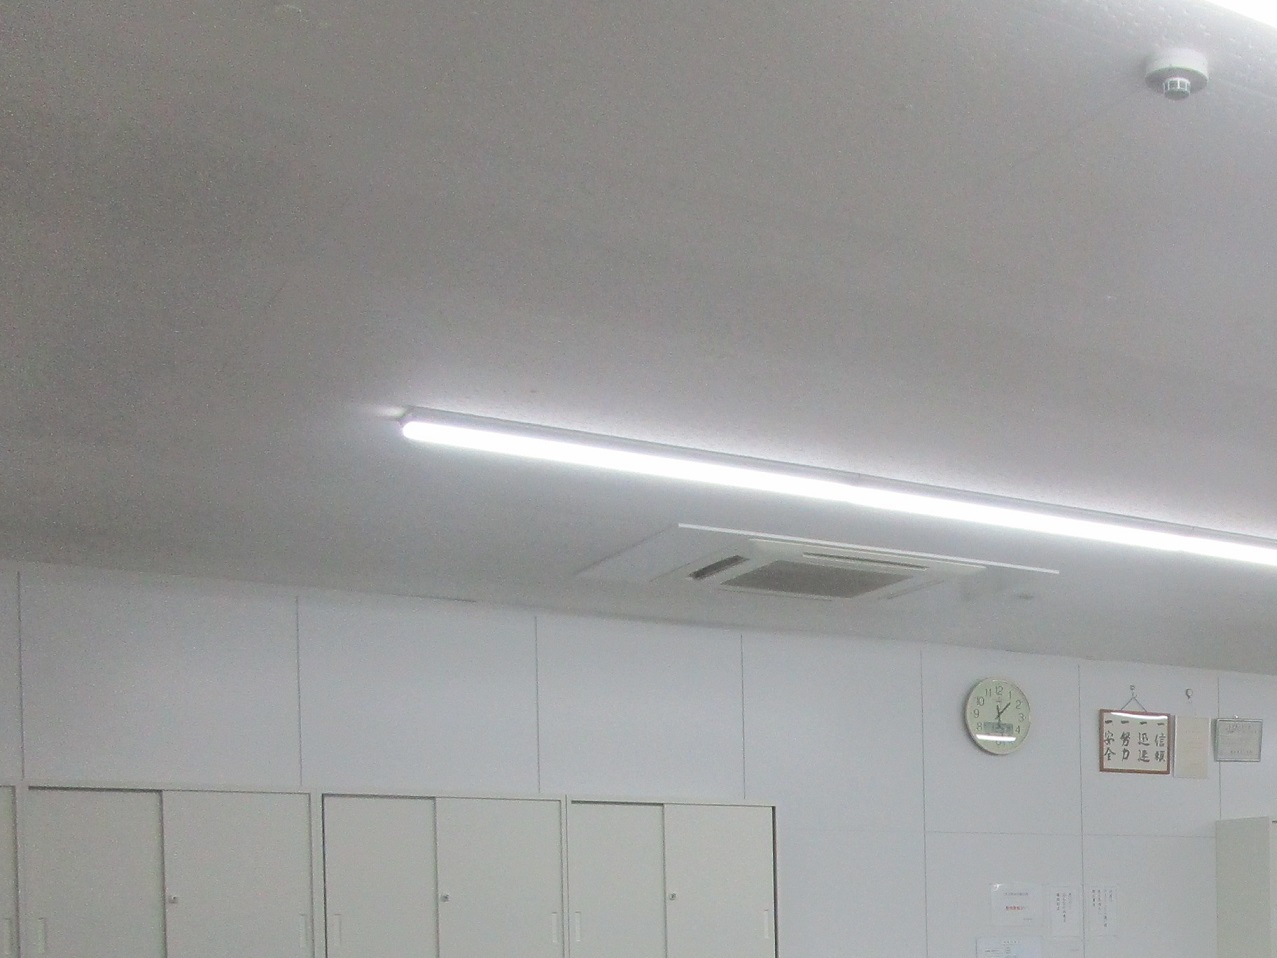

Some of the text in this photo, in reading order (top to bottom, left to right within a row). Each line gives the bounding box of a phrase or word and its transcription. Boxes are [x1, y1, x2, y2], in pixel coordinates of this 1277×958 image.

[985, 688, 992, 697] 11
[995, 686, 1003, 695] 12
[976, 696, 985, 706] 10
[1015, 700, 1021, 709] 2
[973, 709, 979, 718] 9
[976, 722, 982, 731] 8
[1014, 725, 1020, 734] 4
